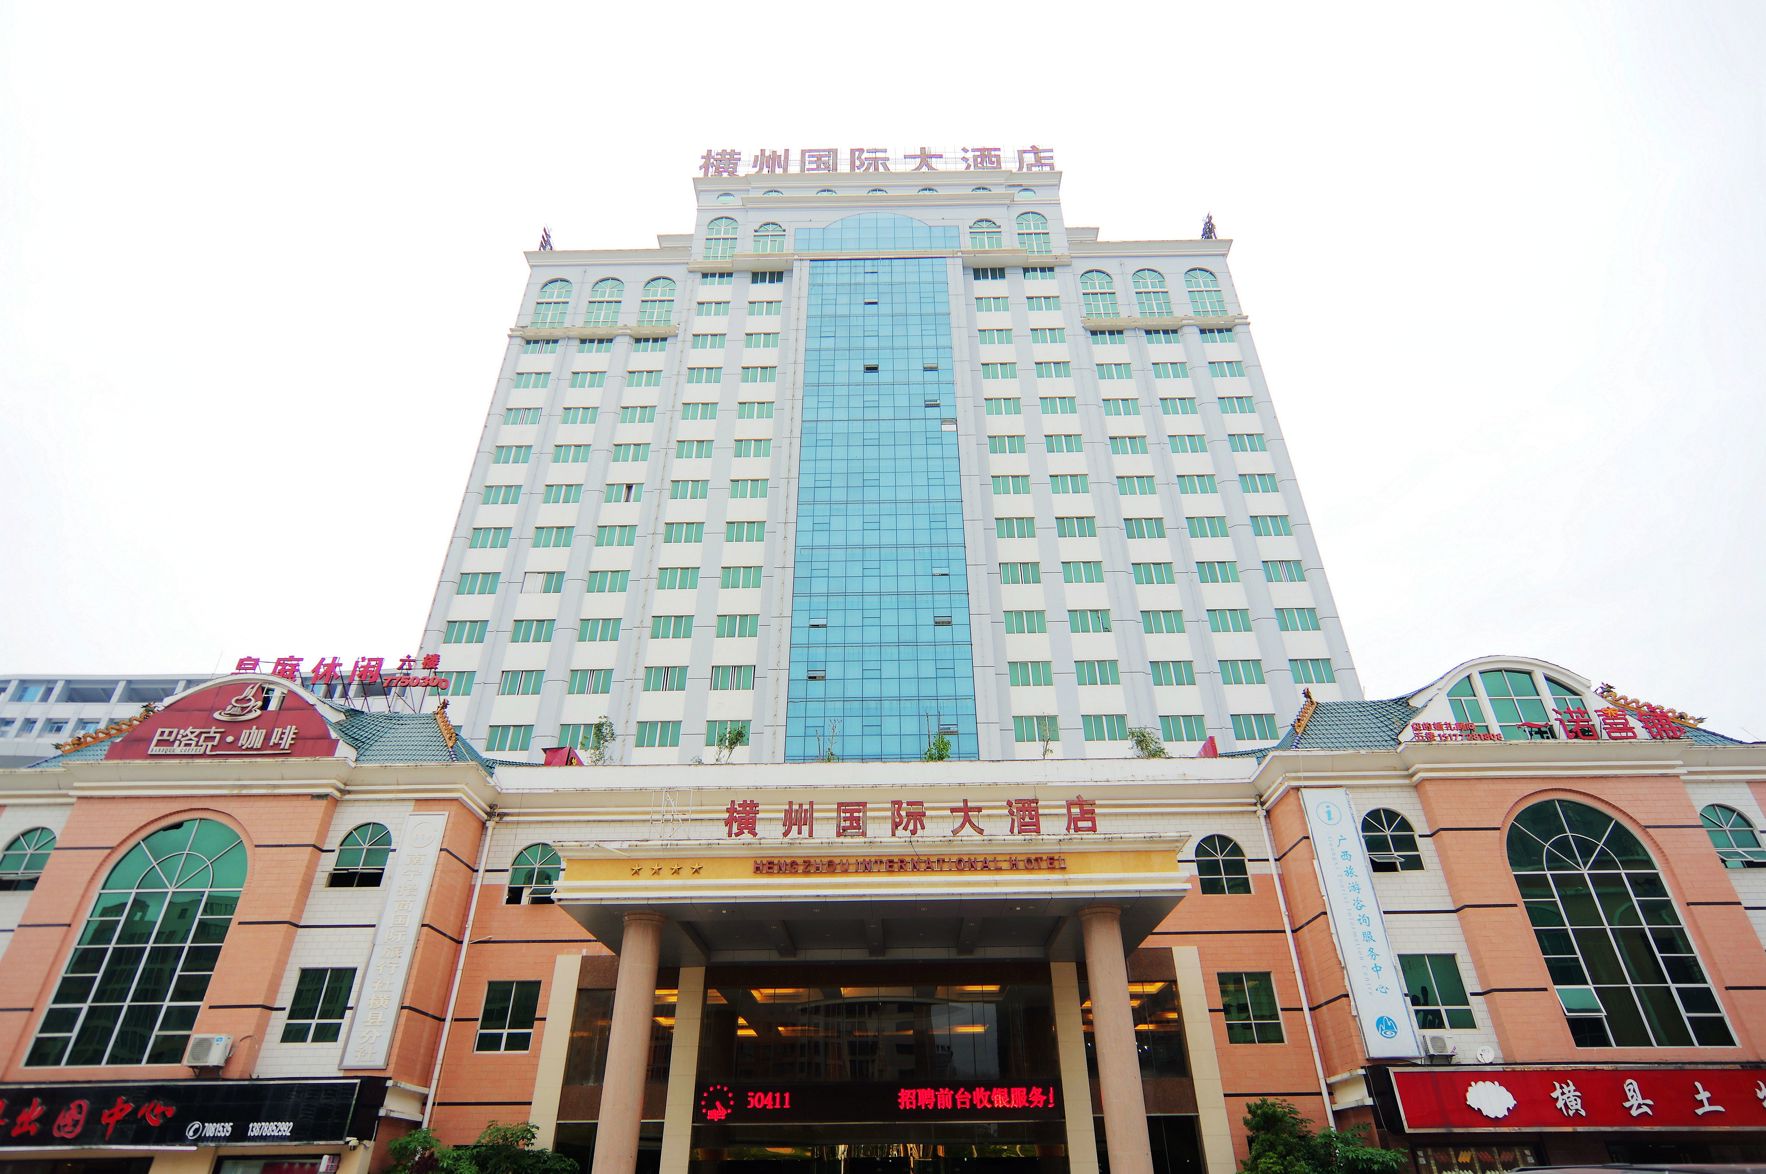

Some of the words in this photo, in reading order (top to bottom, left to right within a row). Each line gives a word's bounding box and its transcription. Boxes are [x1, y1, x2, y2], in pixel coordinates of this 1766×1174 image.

[698, 145, 1055, 177] 横州国际大酒店
[397, 654, 440, 670] 六楼
[383, 675, 450, 690] 7750300
[725, 794, 1098, 838] 横州国际大酒店
[753, 859, 849, 874] HENGZHOU
[855, 857, 1002, 873] INTERNATIONAL
[1009, 856, 1067, 870] HOTEL
[898, 1086, 1055, 1109] 招聘前台收银服务
